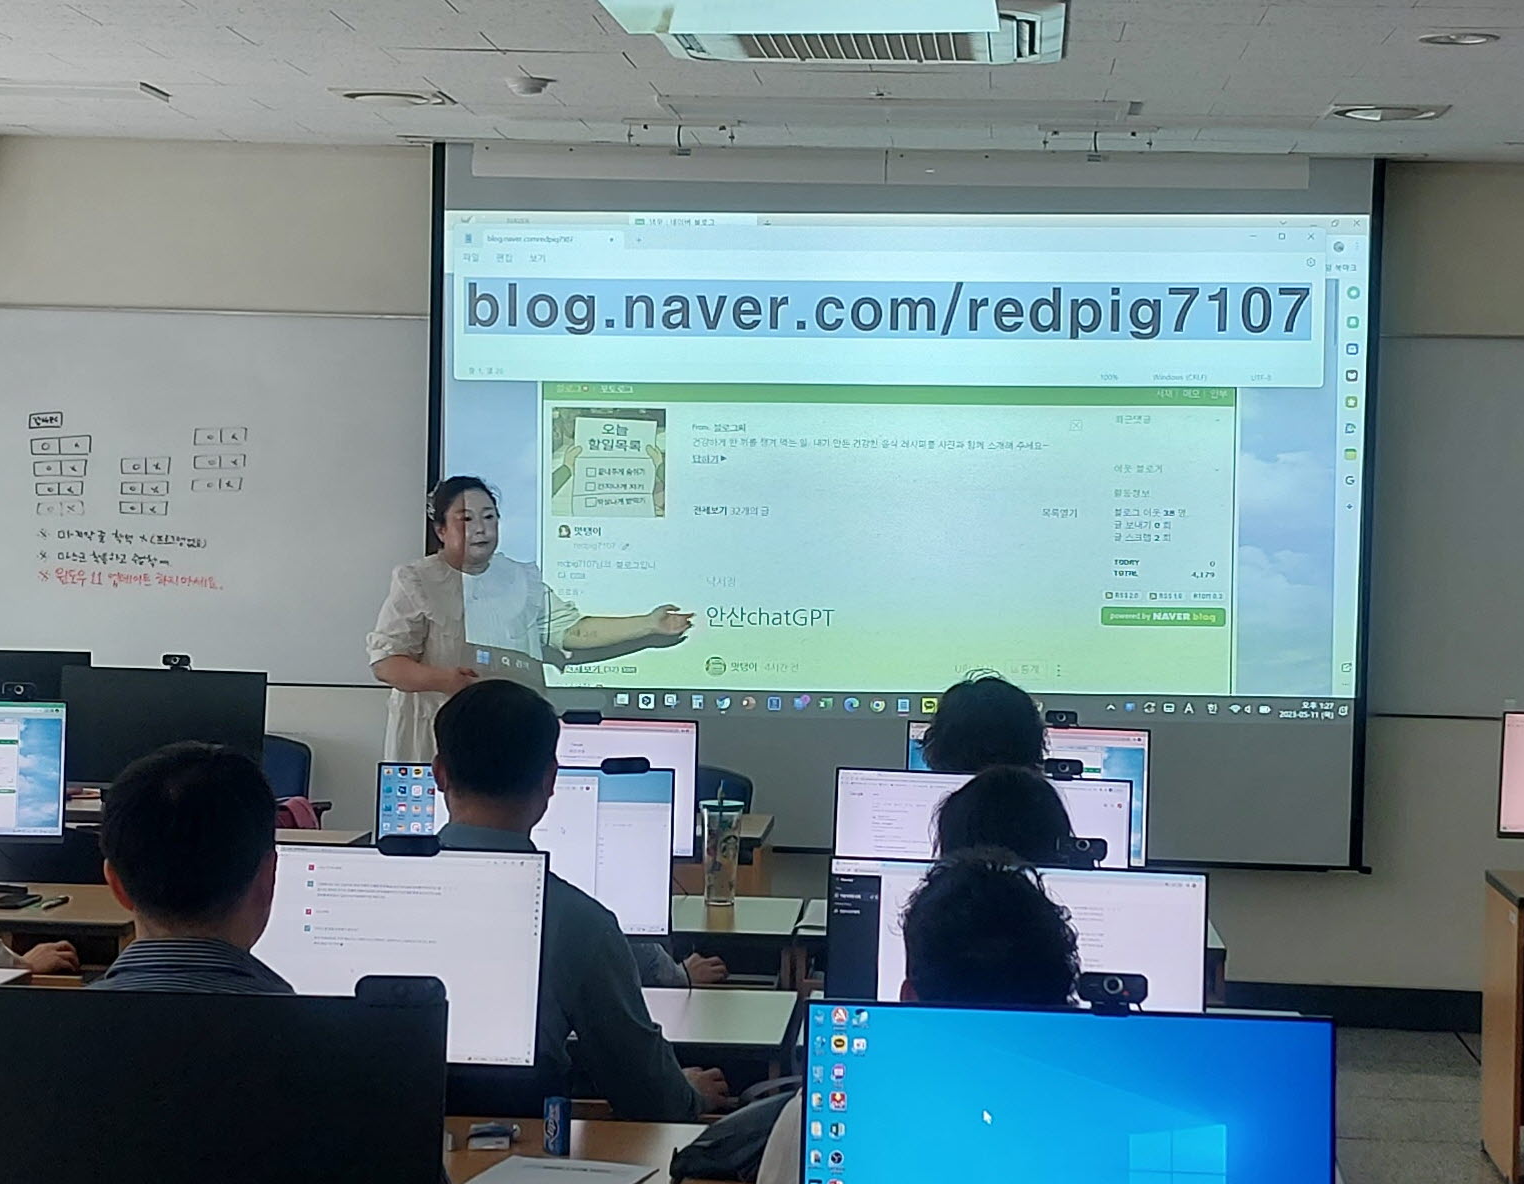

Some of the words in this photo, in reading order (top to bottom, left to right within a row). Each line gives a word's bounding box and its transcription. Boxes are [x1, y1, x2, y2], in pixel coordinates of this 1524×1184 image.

[467, 281, 1311, 340] blog.naver.com/redpig7107
[601, 423, 630, 437] 오늘
[587, 438, 642, 452] 할일목록
[692, 437, 727, 448] 건강하게
[55, 567, 87, 587] 윈도우
[706, 605, 835, 628] 안산chatGPT
[1109, 612, 1140, 621] powered
[1152, 612, 1191, 621] NAVER
[1192, 613, 1217, 623] blog
